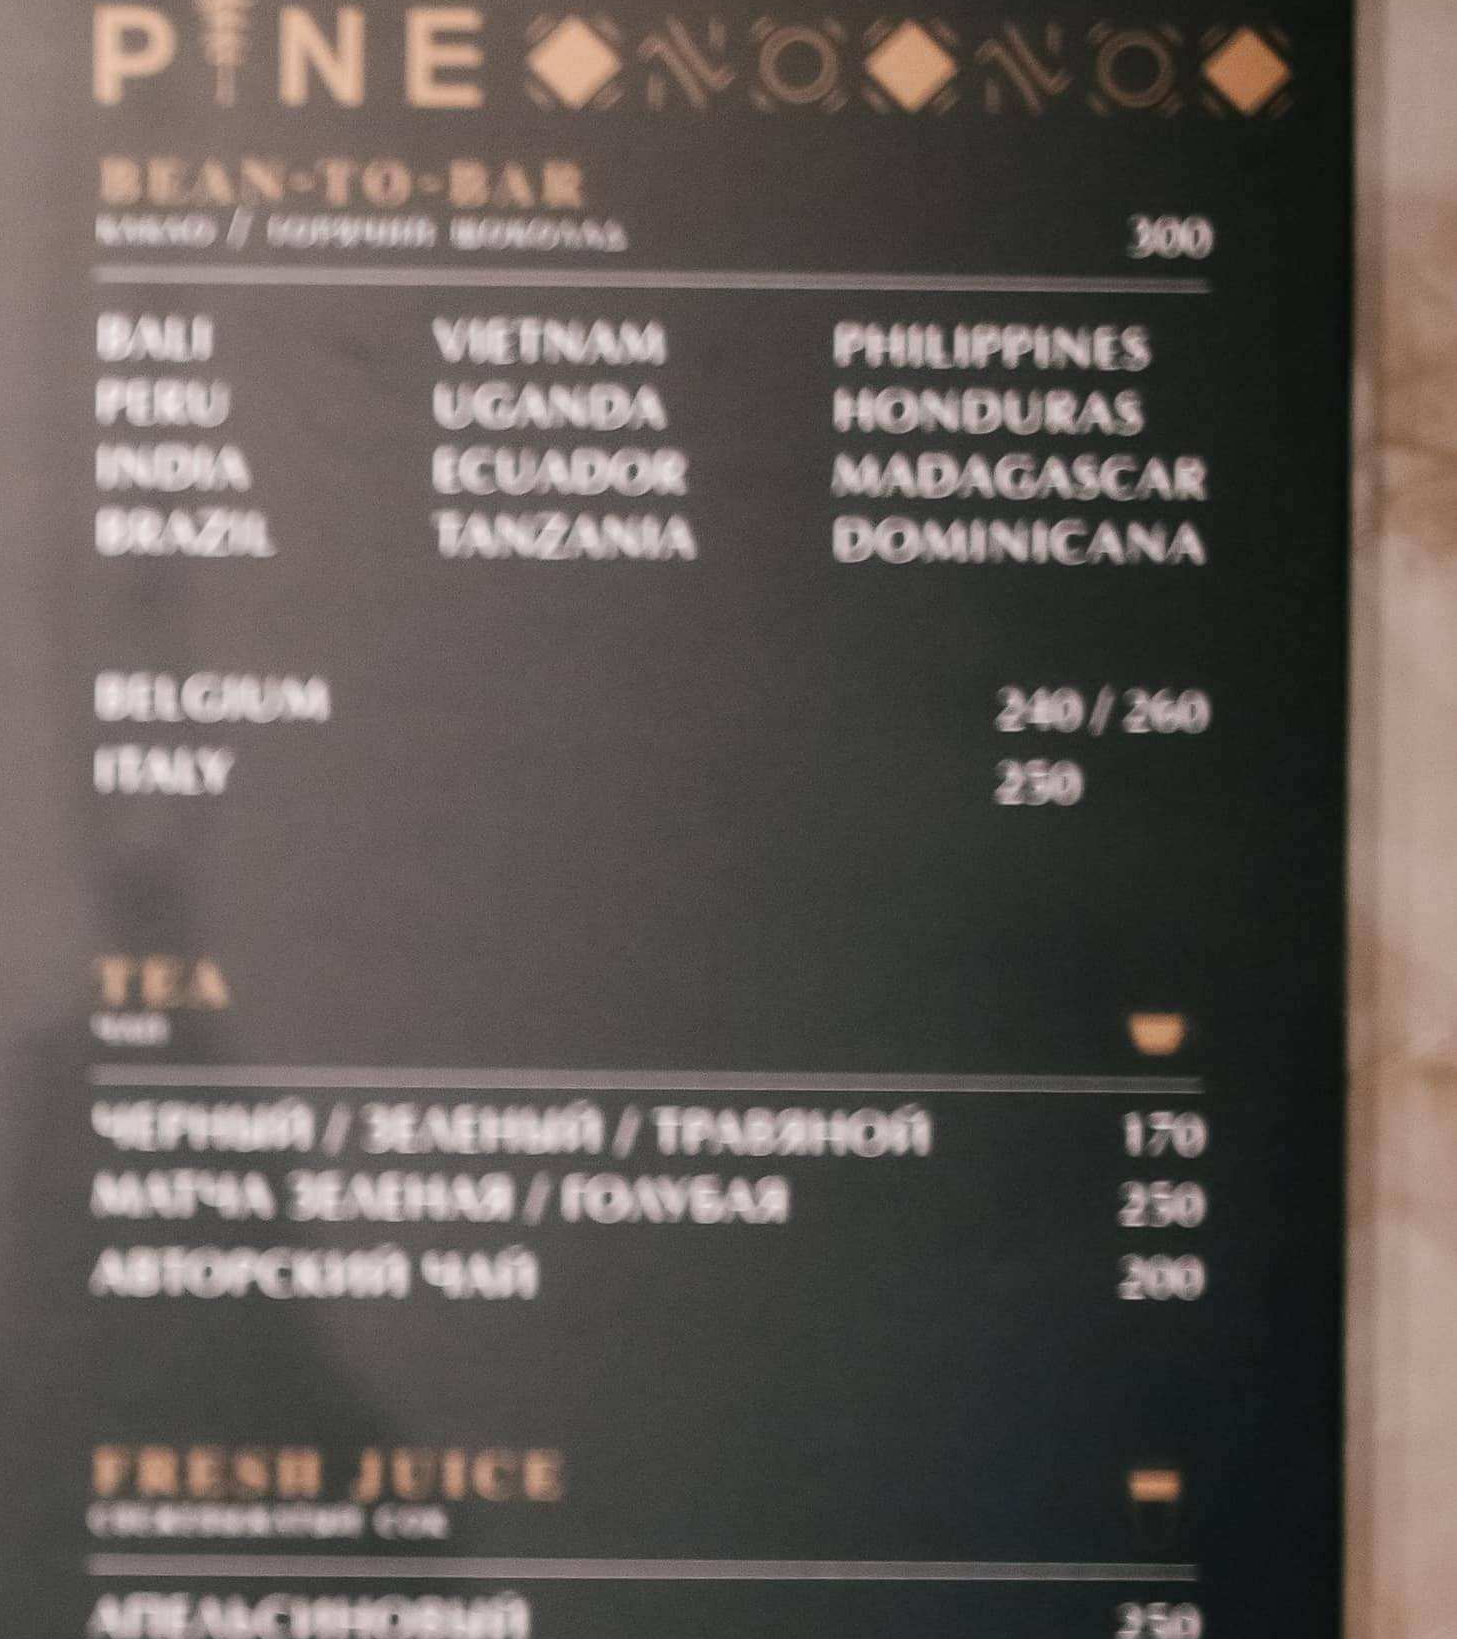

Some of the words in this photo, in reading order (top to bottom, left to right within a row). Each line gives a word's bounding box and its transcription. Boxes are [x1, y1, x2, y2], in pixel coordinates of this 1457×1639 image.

[97, 153, 580, 213] BEAN-TO-BAR
[1135, 217, 1213, 257] 300
[96, 313, 213, 361] BALI
[432, 317, 666, 365] VIETNAM
[833, 321, 1150, 370] PHILIPPINES
[95, 378, 229, 426] PERU
[433, 382, 666, 430] UGANDA
[833, 387, 1143, 434] HONDURAS
[96, 444, 250, 490] INDIA
[432, 445, 687, 495] ECUADOR
[831, 452, 1205, 499] MADAGASCAR
[95, 507, 272, 556] BRAZIL
[433, 510, 695, 559] TANZANIA
[832, 515, 1204, 564] DOMINICANA
[95, 673, 330, 722] BELGIUM
[997, 688, 1084, 732] 240
[1124, 689, 1210, 733] 260
[94, 745, 232, 794] ITALY
[996, 759, 1083, 805] 250
[96, 957, 229, 1008] TEA
[92, 1098, 315, 1151] ЧЕРНЫЙ
[366, 1102, 603, 1153] ЗЕЛЕНЫЙ
[654, 1106, 931, 1156] ТРАВЯНОЙ
[1125, 1111, 1207, 1156] 170
[92, 1169, 274, 1217] МАТЧА
[284, 1171, 514, 1221] ЗЕЛЕНАЯ
[561, 1173, 789, 1223] ГОЛУБАЯ
[1120, 1181, 1206, 1227] 250
[92, 1244, 411, 1297] АВТОРСКИЙ
[421, 1248, 538, 1298] ЧАЙ
[1120, 1256, 1205, 1300] 200
[94, 1447, 320, 1496] FRESH
[356, 1449, 559, 1501] JUICE
